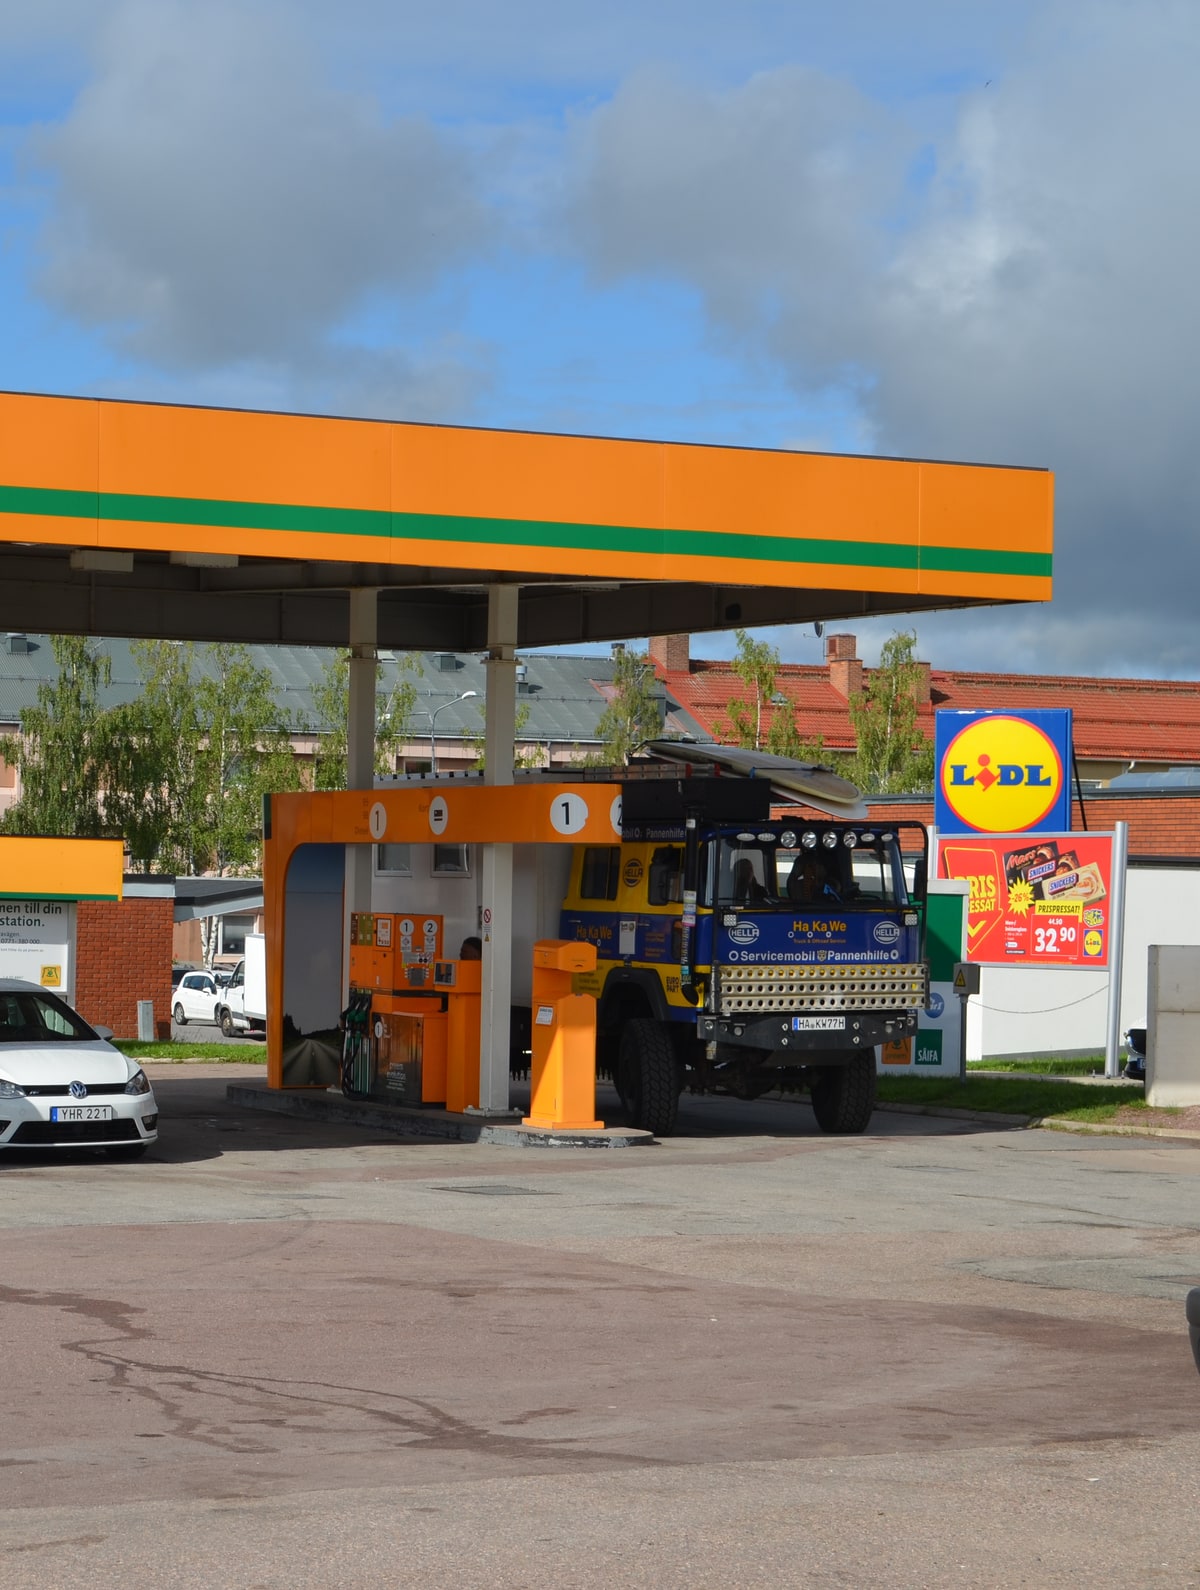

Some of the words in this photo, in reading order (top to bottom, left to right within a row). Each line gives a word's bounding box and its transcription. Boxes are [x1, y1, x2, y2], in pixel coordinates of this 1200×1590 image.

[561, 801, 570, 825] 1
[375, 809, 380, 832] 1
[646, 827, 684, 839] Pannenhilfe
[1006, 849, 1036, 871] Mars
[1029, 862, 1054, 878] SNICKERS
[954, 874, 996, 899] RIS
[1049, 875, 1075, 891] SNICKERS
[24, 902, 41, 914] till
[43, 903, 62, 915] din
[968, 898, 996, 914] ESSAT
[1038, 904, 1080, 914] PRISPRESSAT!
[404, 922, 409, 933] 1
[427, 922, 433, 933] 2
[793, 920, 809, 932] Ha
[812, 920, 828, 932] Ka
[829, 920, 847, 932] We
[875, 927, 900, 937] HELLA
[731, 927, 760, 938] HELLA
[740, 950, 816, 962] Servicemobil
[827, 950, 890, 961] Pannenhilfe
[799, 1019, 810, 1029] HA
[61, 1108, 83, 1120] YHR
[86, 1108, 107, 1120] 221
